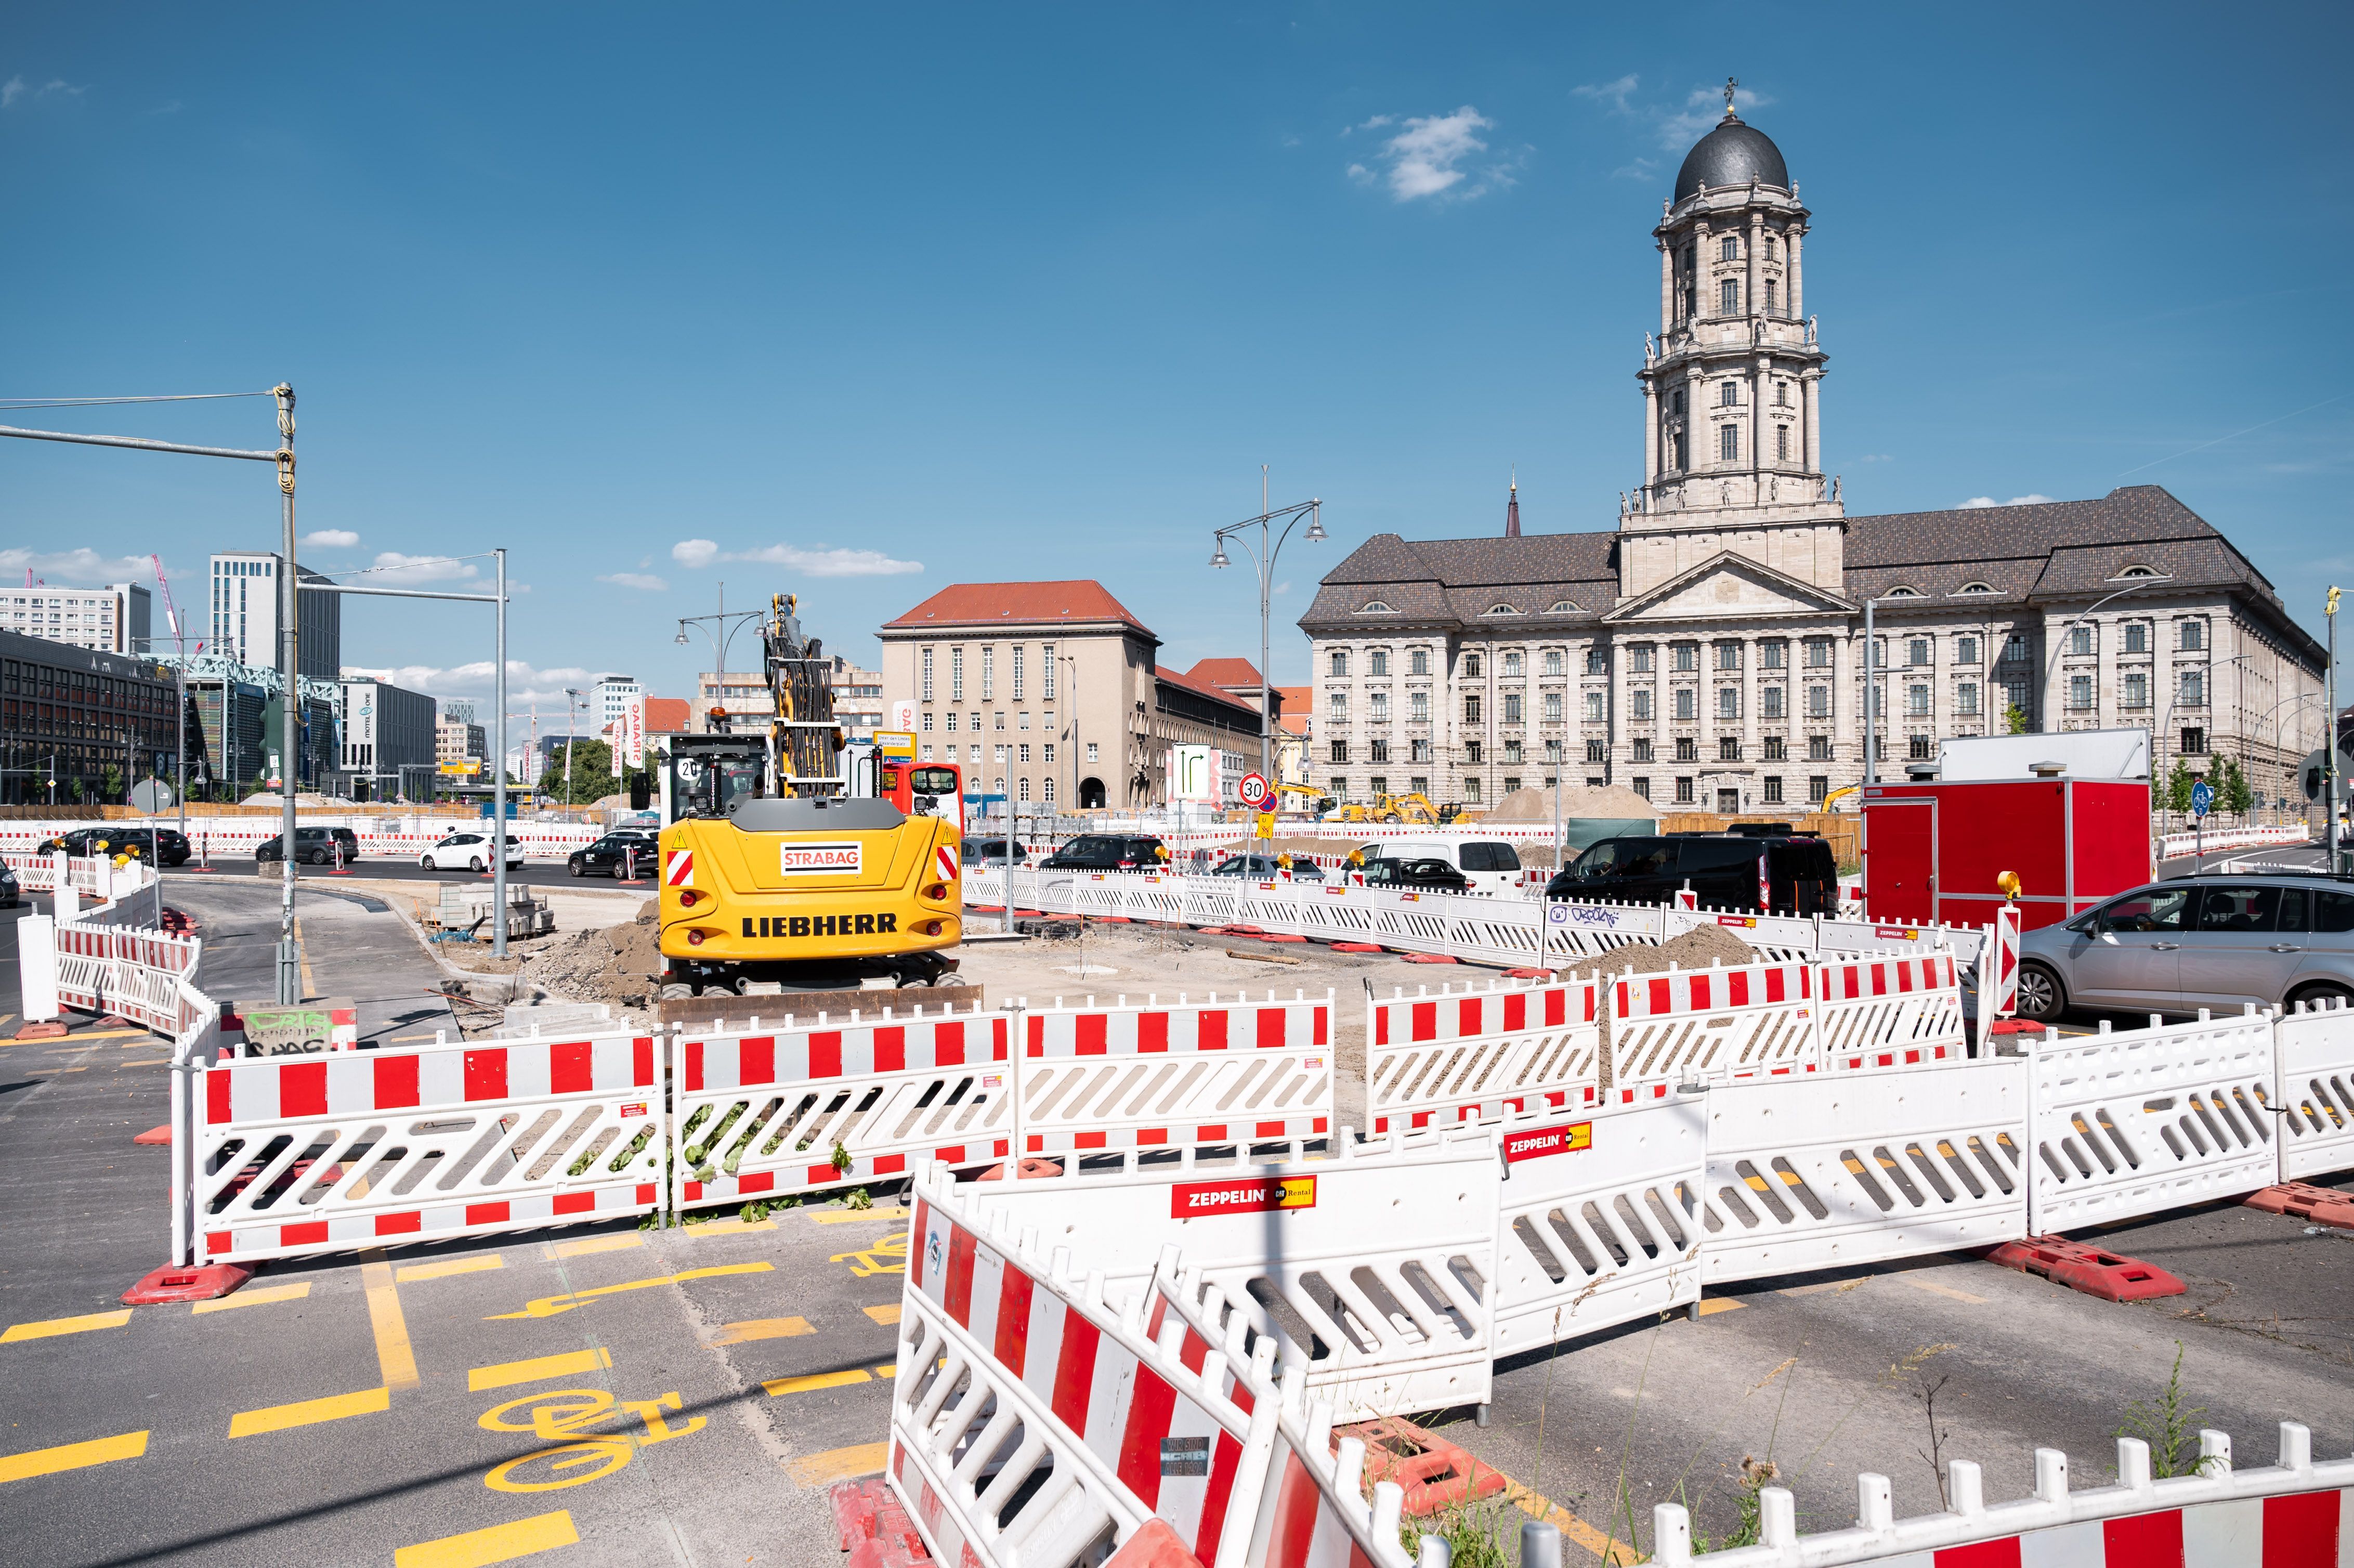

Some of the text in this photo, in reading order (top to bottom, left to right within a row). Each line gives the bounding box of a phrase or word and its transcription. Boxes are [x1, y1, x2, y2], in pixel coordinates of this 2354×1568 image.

[683, 762, 697, 776] 20
[1244, 782, 1262, 798] 30
[784, 851, 859, 866] STRABAG
[742, 912, 897, 938] LIEBHERR
[1510, 1134, 1560, 1154] ZEPPELIN
[1188, 1188, 1311, 1207] ZEPPELIN CAT Rental
[1167, 1437, 1204, 1452] WIR SIND
[1165, 1461, 1204, 1476] ALLE 129A
